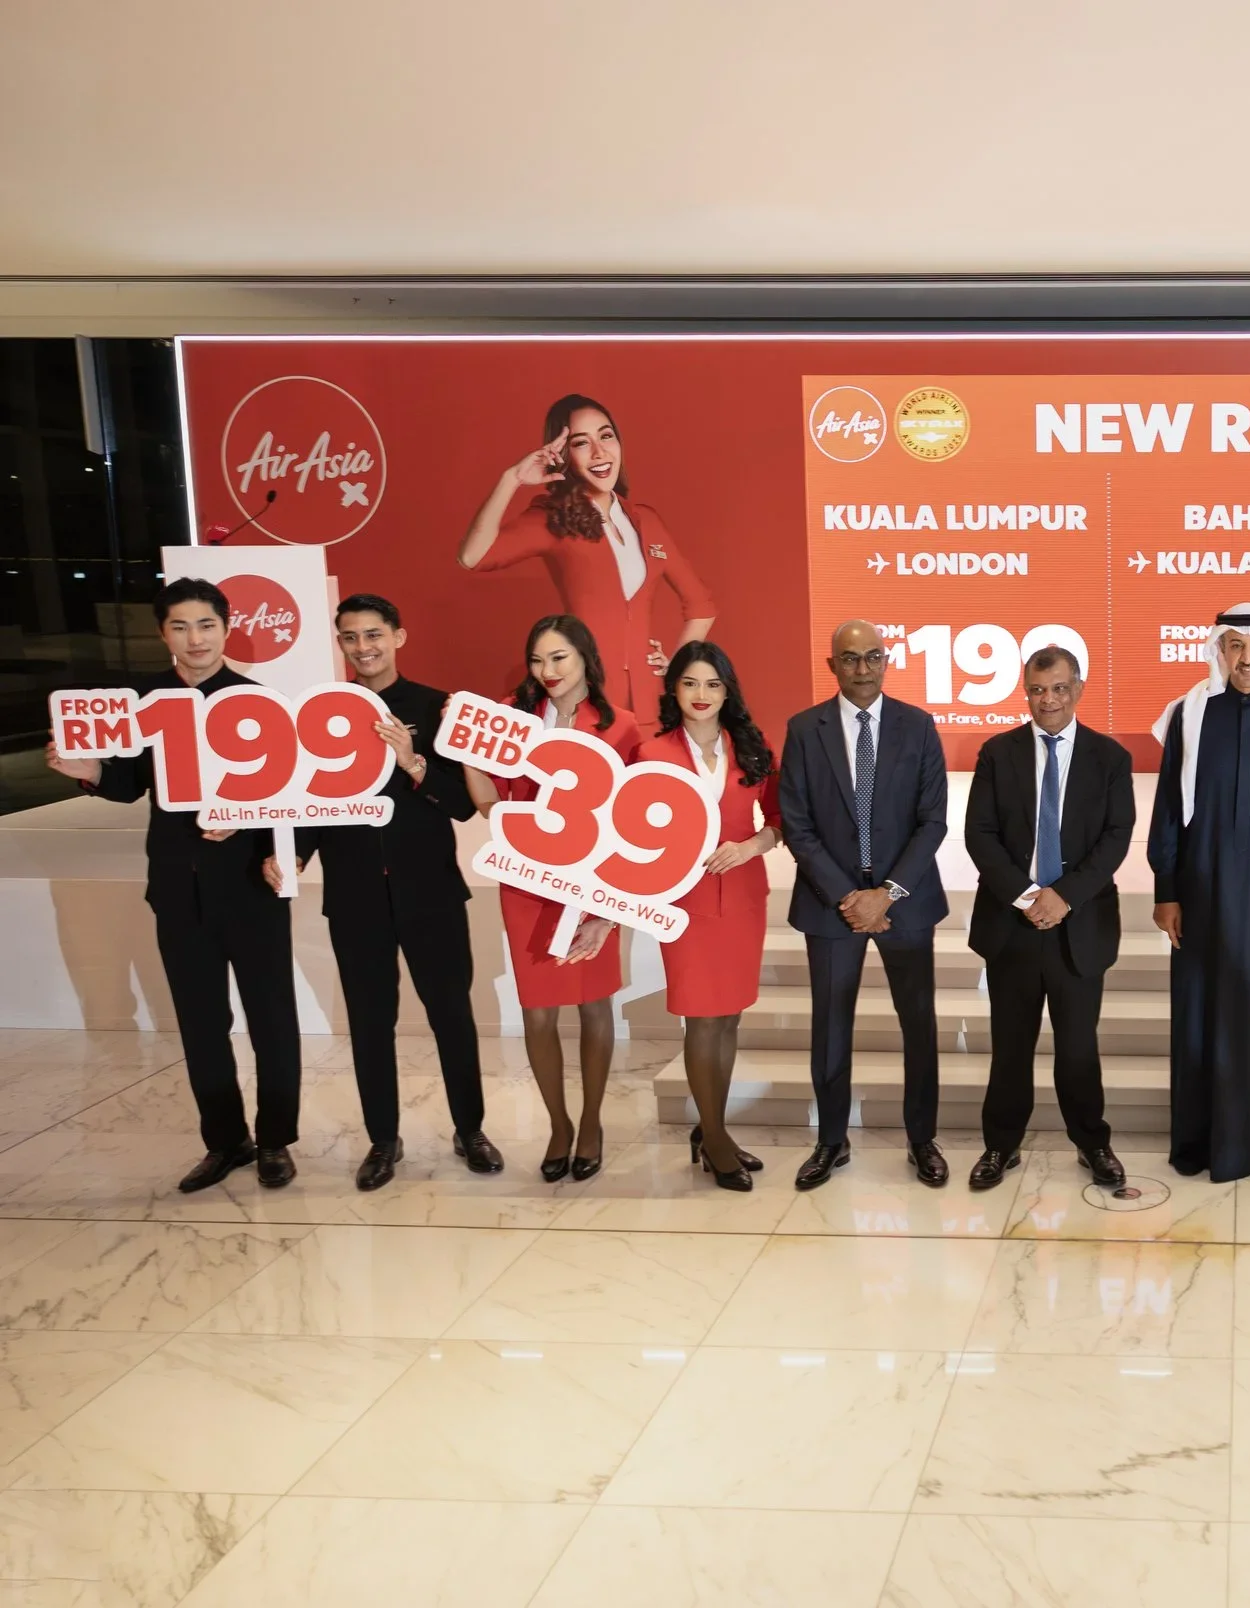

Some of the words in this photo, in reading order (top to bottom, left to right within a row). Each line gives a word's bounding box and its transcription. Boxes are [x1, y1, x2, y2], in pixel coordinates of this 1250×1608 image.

[1035, 403, 1194, 454] NEW
[824, 505, 939, 531] KUALA
[946, 504, 1088, 531] LUMPUR
[897, 553, 1028, 576] LONDON
[229, 602, 296, 636] irAsia
[875, 624, 905, 638] OM
[60, 698, 129, 716] FROM
[457, 703, 532, 743] FROM
[64, 718, 133, 750] RM
[136, 692, 389, 803] 199
[448, 724, 522, 767] BHD
[259, 806, 301, 823] Fare,
[305, 803, 385, 822] One-Way
[502, 740, 708, 895] 39
[540, 871, 585, 900] Fare,
[592, 889, 677, 931] One-Way
